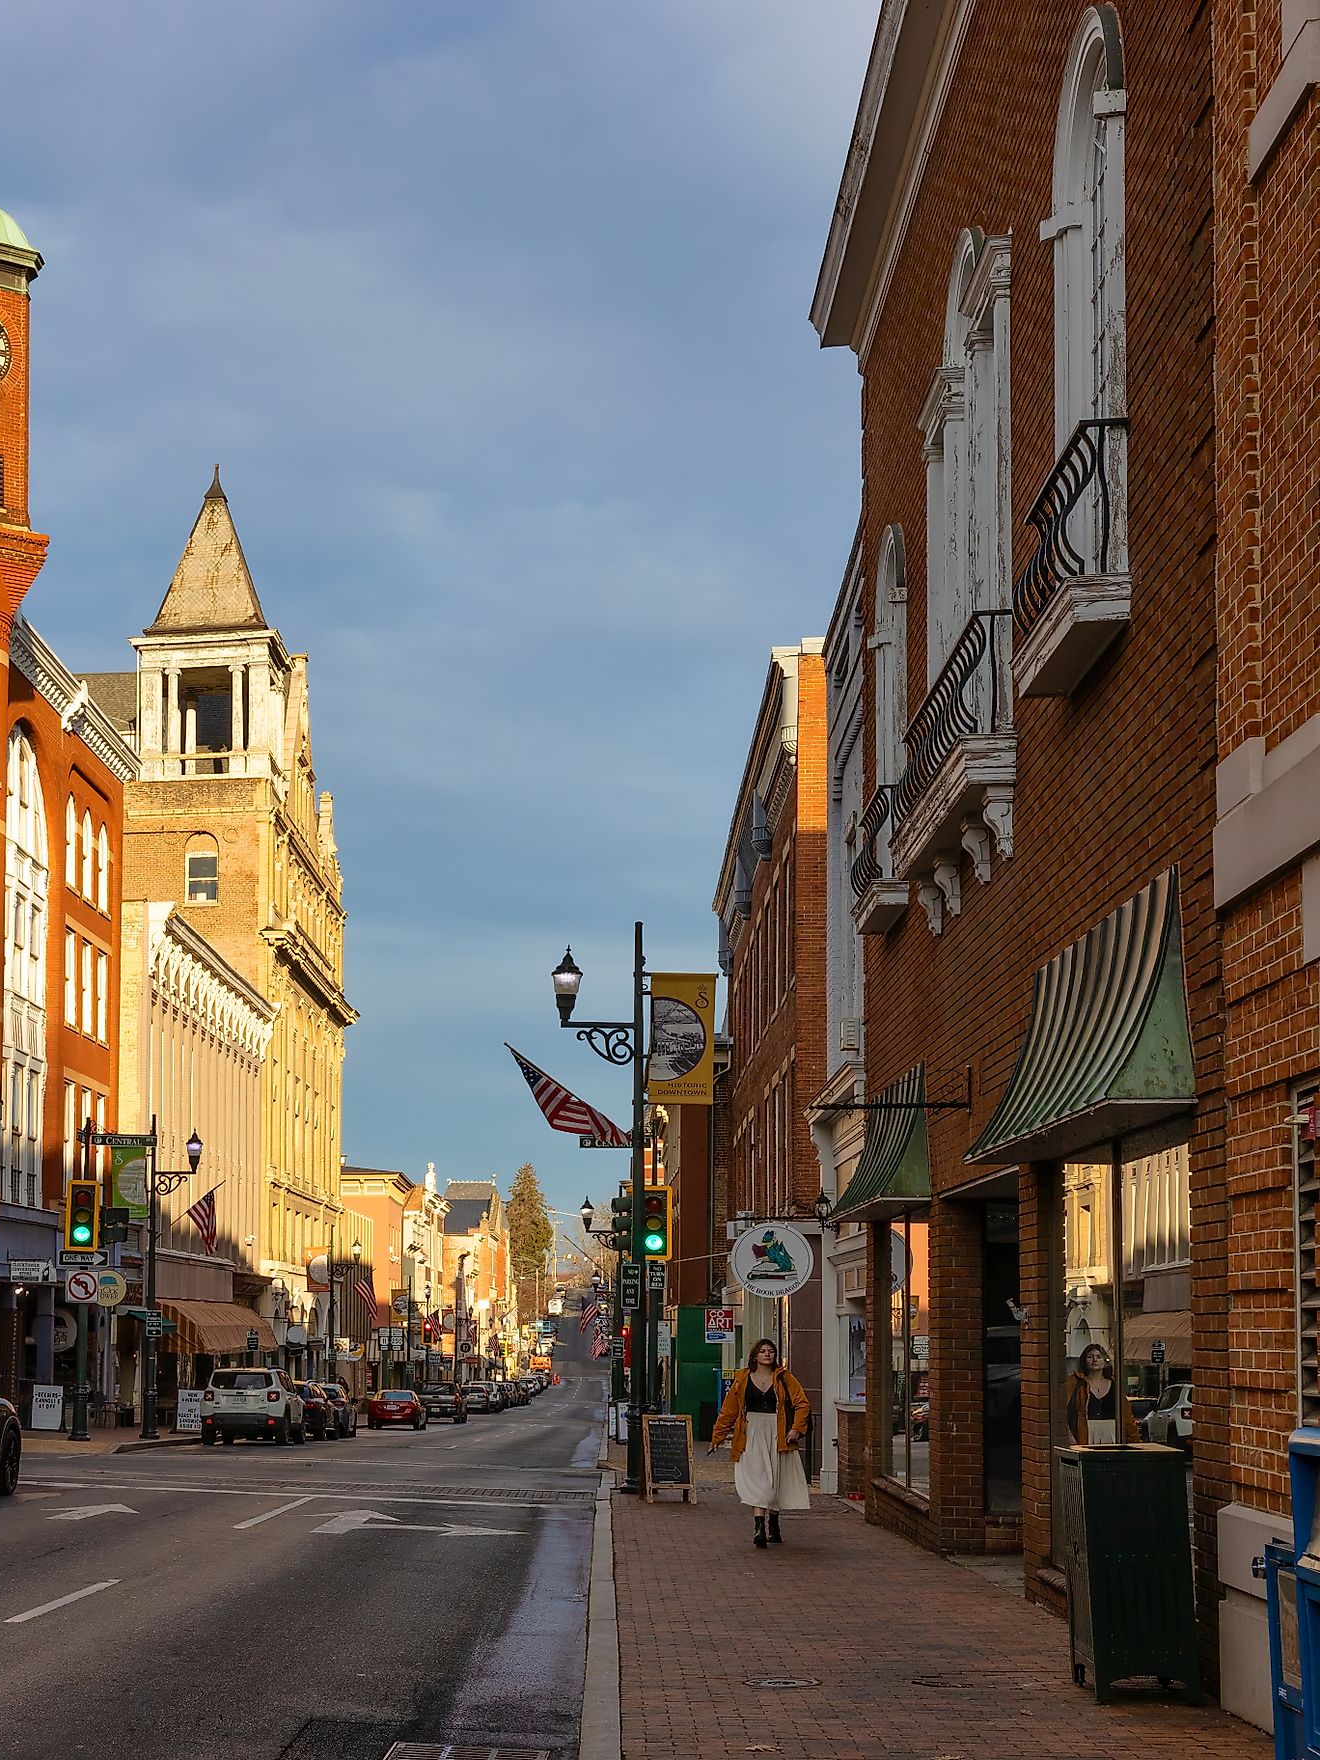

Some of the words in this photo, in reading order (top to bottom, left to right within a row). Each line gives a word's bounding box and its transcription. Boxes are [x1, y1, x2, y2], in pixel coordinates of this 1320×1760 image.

[695, 991, 710, 1009] S
[105, 1136, 143, 1146] CENTRAL
[594, 1139, 632, 1147] CENRA
[64, 1254, 79, 1262] ONE
[743, 1281, 757, 1292] THE
[755, 1288, 775, 1296] BOOK
[775, 1279, 802, 1296] DRAGON
[709, 1310, 725, 1318] CO
[707, 1317, 733, 1329] ART
